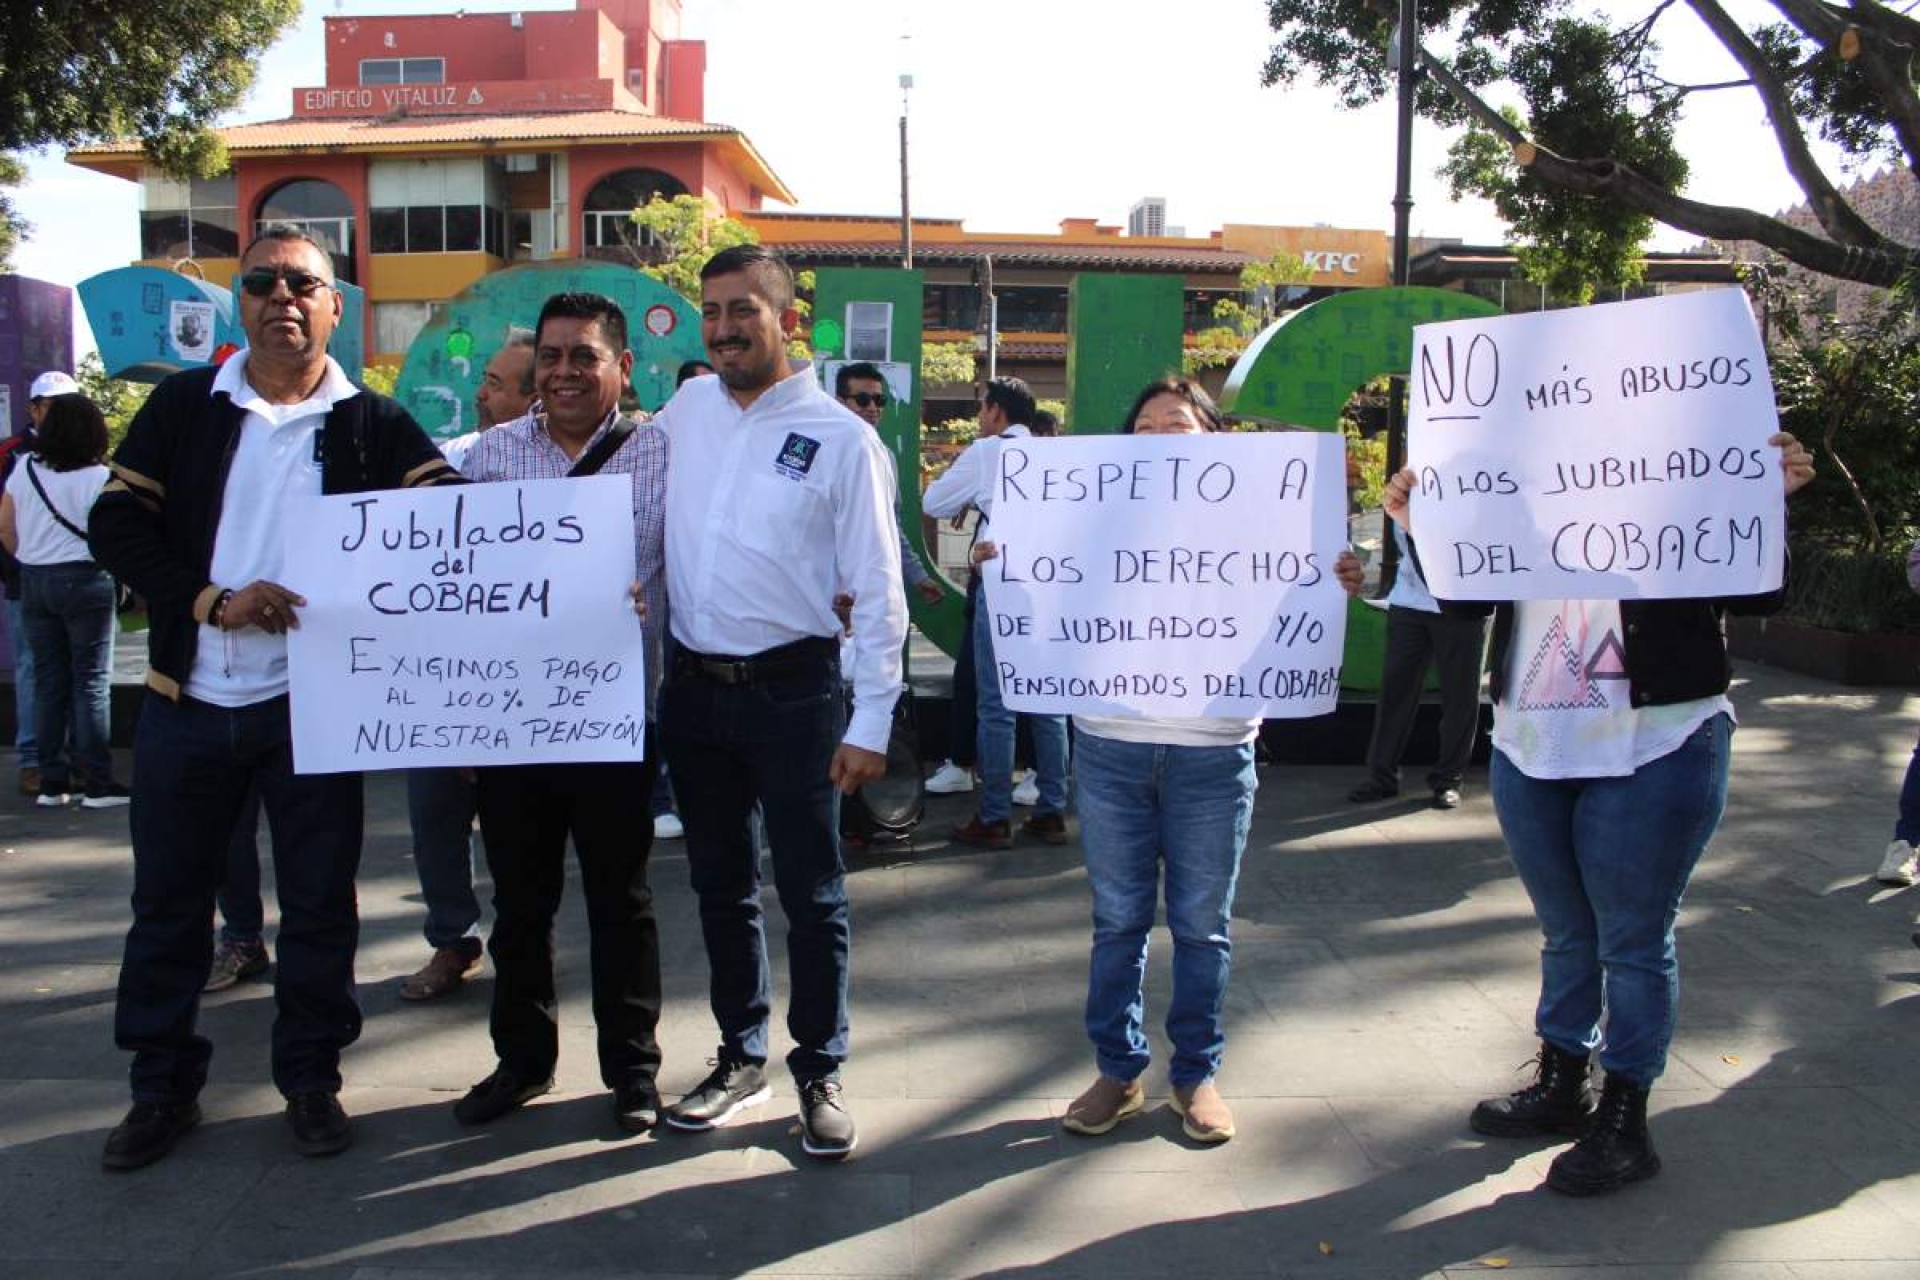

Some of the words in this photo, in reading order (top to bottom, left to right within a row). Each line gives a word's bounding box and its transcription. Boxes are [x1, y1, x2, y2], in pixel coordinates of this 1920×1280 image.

[305, 89, 372, 110] EDIFICIO
[382, 87, 457, 106] VITALUZ
[1303, 251, 1359, 273] KFC
[1420, 333, 1500, 408] NO
[1526, 364, 1593, 410] MÁS
[1621, 356, 1753, 398] ABUSOS
[1001, 448, 1236, 503] RESPETO
[1279, 458, 1309, 501] A
[1420, 466, 1443, 500] A
[1458, 470, 1519, 495] LOS
[1543, 447, 1766, 495] JUBILADOS
[342, 488, 584, 551] Jubilados
[431, 549, 475, 577] del
[1001, 543, 1084, 584] LOS
[1113, 547, 1322, 586] DERECHOS
[1453, 540, 1532, 580] DEL
[1552, 516, 1762, 572] COBAEM
[368, 578, 550, 618] COBAEM
[996, 613, 1033, 638] DE
[1050, 616, 1238, 644] JUBILADOS
[1274, 611, 1324, 648] Y/O
[350, 637, 519, 682] EXIGIMOS
[541, 658, 622, 685] PAGO
[999, 661, 1188, 698] PENSIONADOS
[387, 687, 416, 704] AL
[444, 688, 524, 712] 100%
[548, 686, 591, 708] DE
[355, 719, 510, 754] NUESTRA
[520, 714, 643, 747] PENSIÓN
